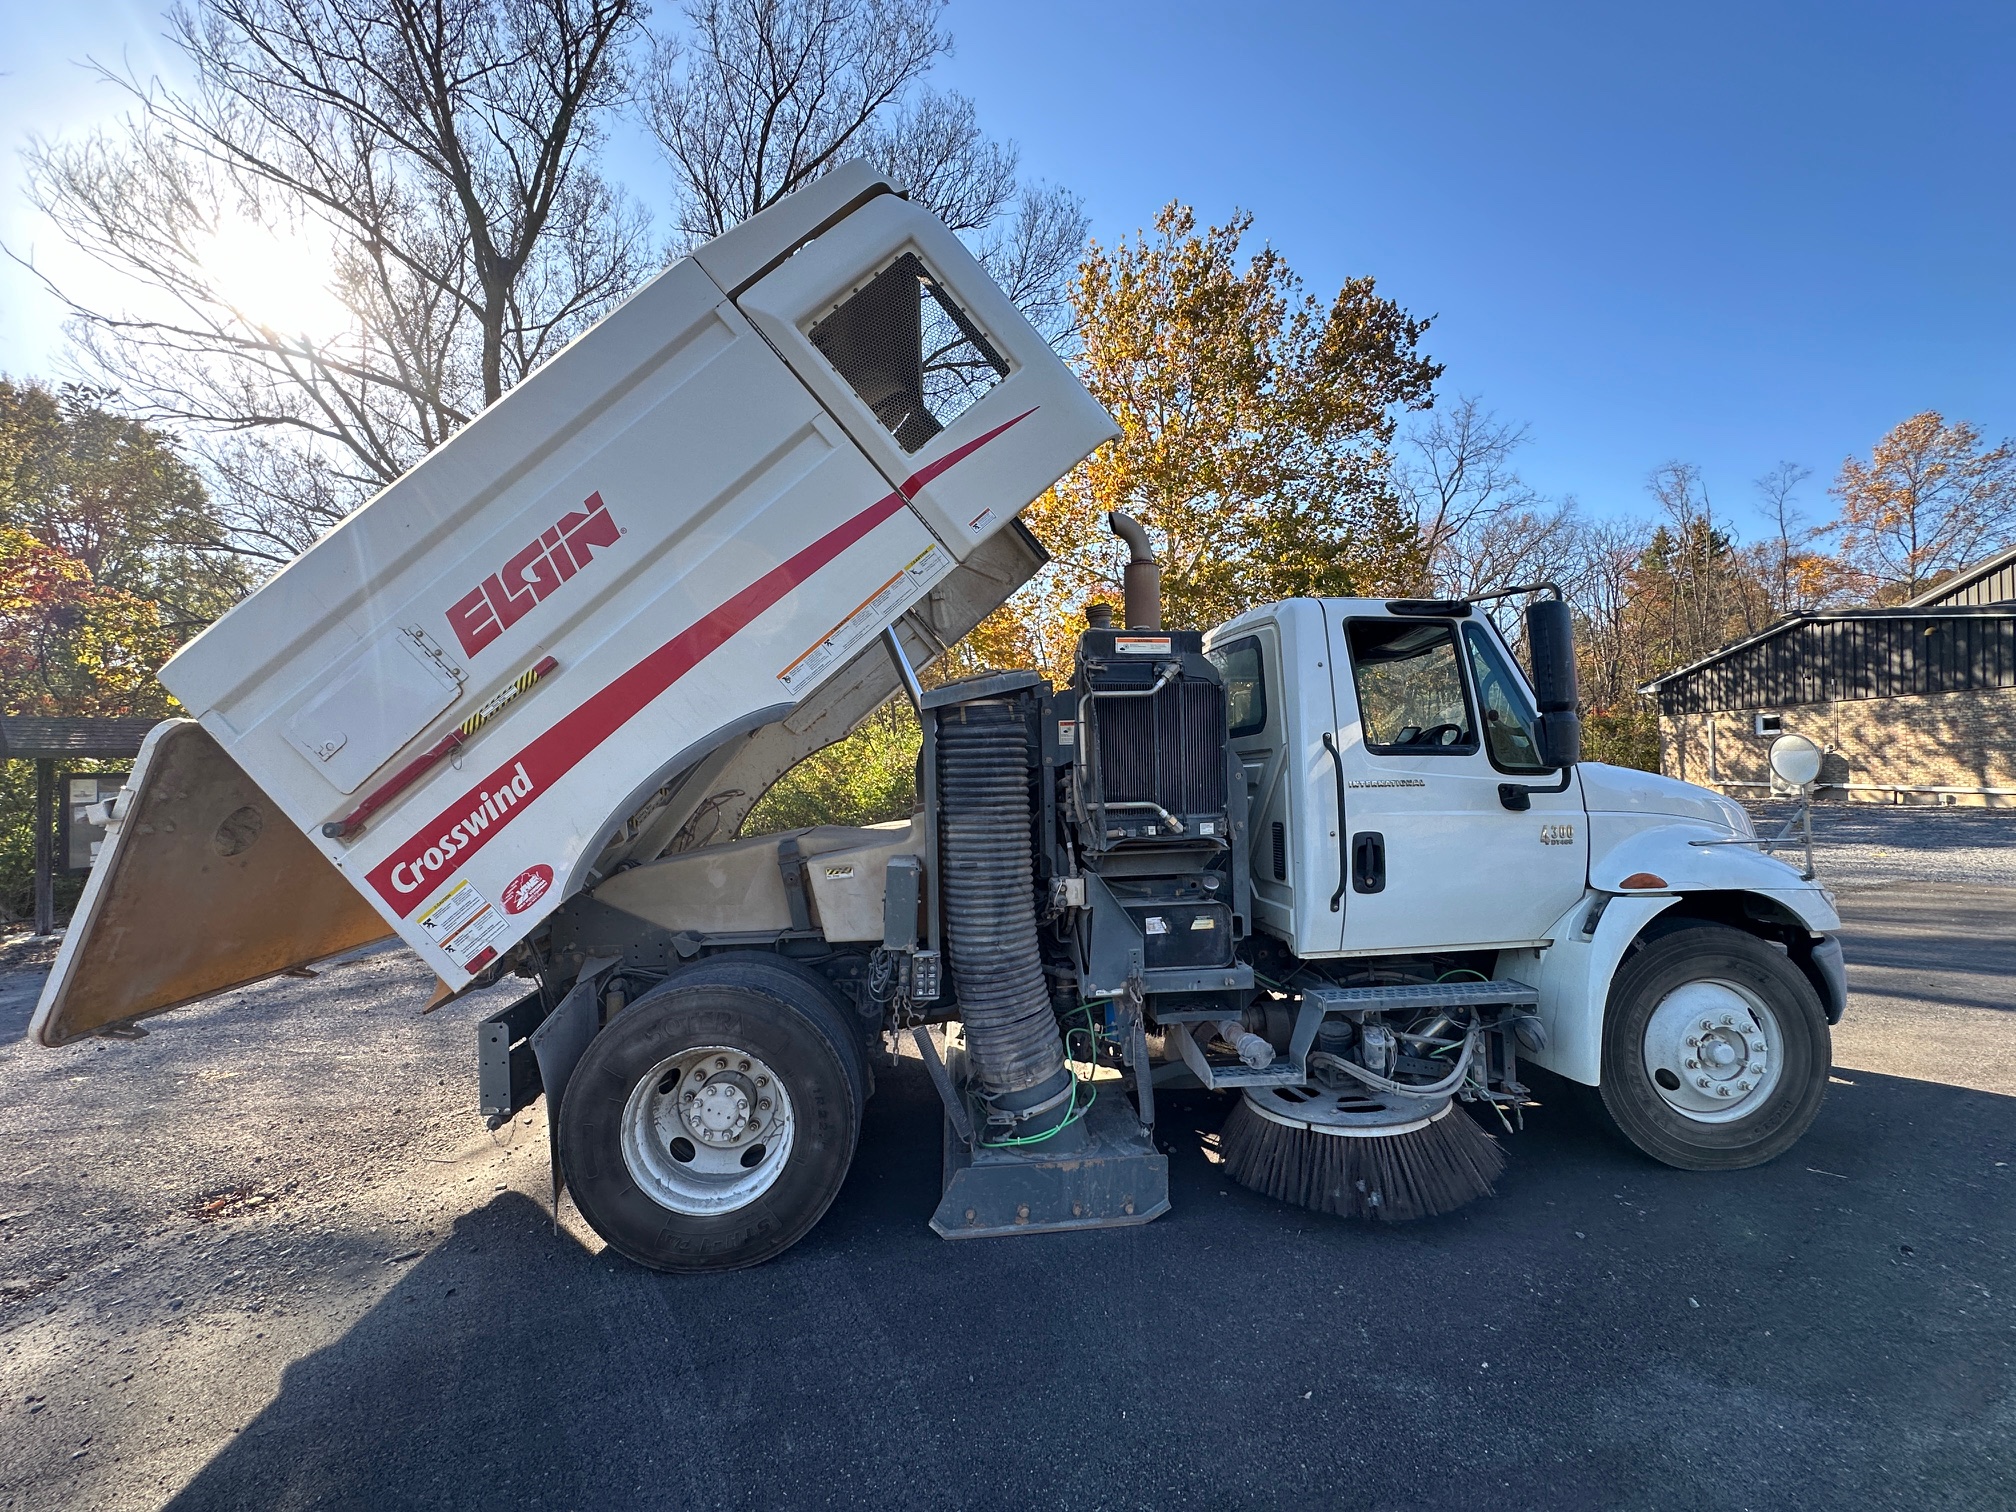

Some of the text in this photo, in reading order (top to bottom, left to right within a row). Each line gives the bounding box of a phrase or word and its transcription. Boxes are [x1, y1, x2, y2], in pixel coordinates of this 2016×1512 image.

[445, 490, 621, 660] ELGIN
[1348, 779, 1426, 788] INTERNATIONAL
[391, 762, 534, 893] Crosswind
[1540, 824, 1574, 845] 4300
